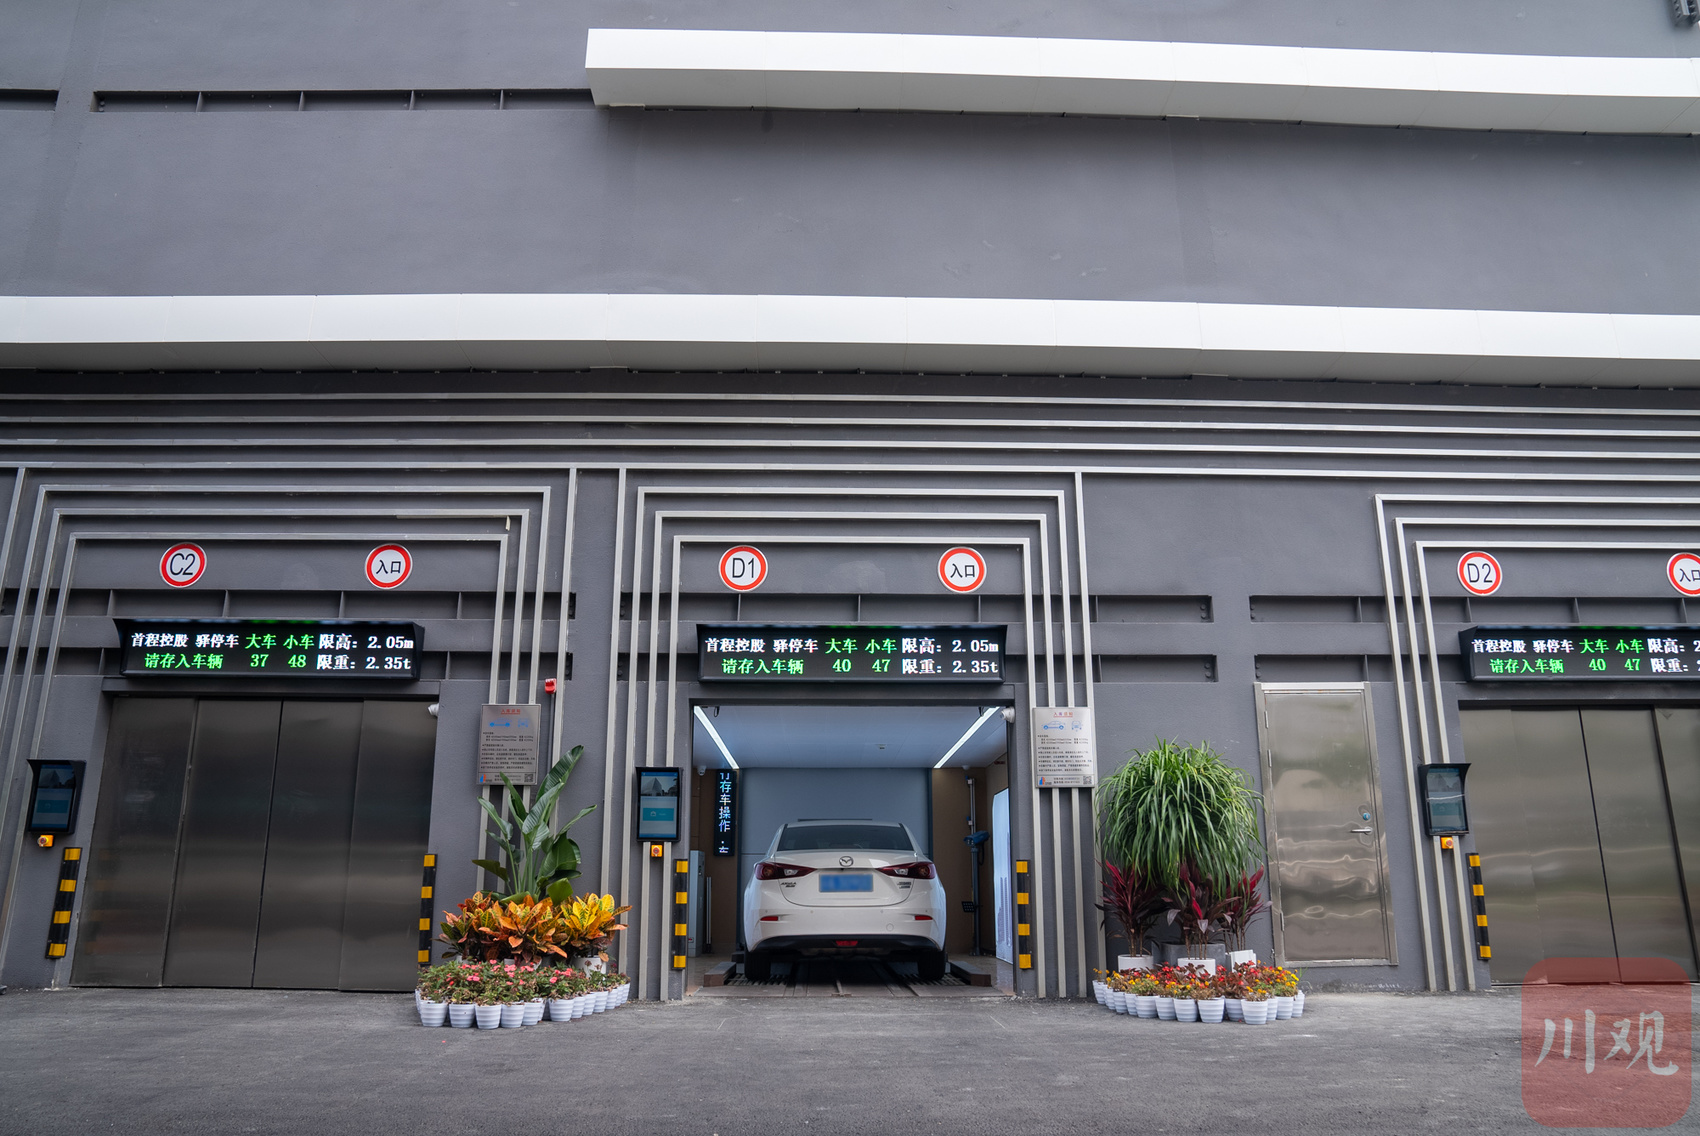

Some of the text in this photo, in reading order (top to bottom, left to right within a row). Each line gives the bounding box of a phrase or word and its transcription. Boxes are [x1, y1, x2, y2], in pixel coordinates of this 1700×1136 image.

[170, 553, 195, 576] C2
[376, 560, 401, 574] 入口
[732, 557, 754, 578] D1
[950, 563, 975, 578] 入口
[1467, 563, 1492, 583] D2
[131, 633, 189, 648] 首程控股
[245, 633, 277, 649] 大车
[283, 634, 315, 650] 小车
[705, 638, 766, 653] 首程控股
[825, 638, 858, 654] 大车
[864, 638, 897, 653] 小车
[1579, 639, 1609, 654] 大车
[1615, 640, 1645, 654] 小车
[144, 653, 224, 669] 请存入车辆
[250, 654, 269, 668] 37
[287, 655, 306, 668] 48
[721, 658, 804, 674] 请存入车辆
[832, 659, 851, 673] 40
[872, 659, 891, 673] 47
[1489, 659, 1564, 674] 请存入车辆
[1588, 659, 1607, 671] 40
[1624, 659, 1641, 671] 47
